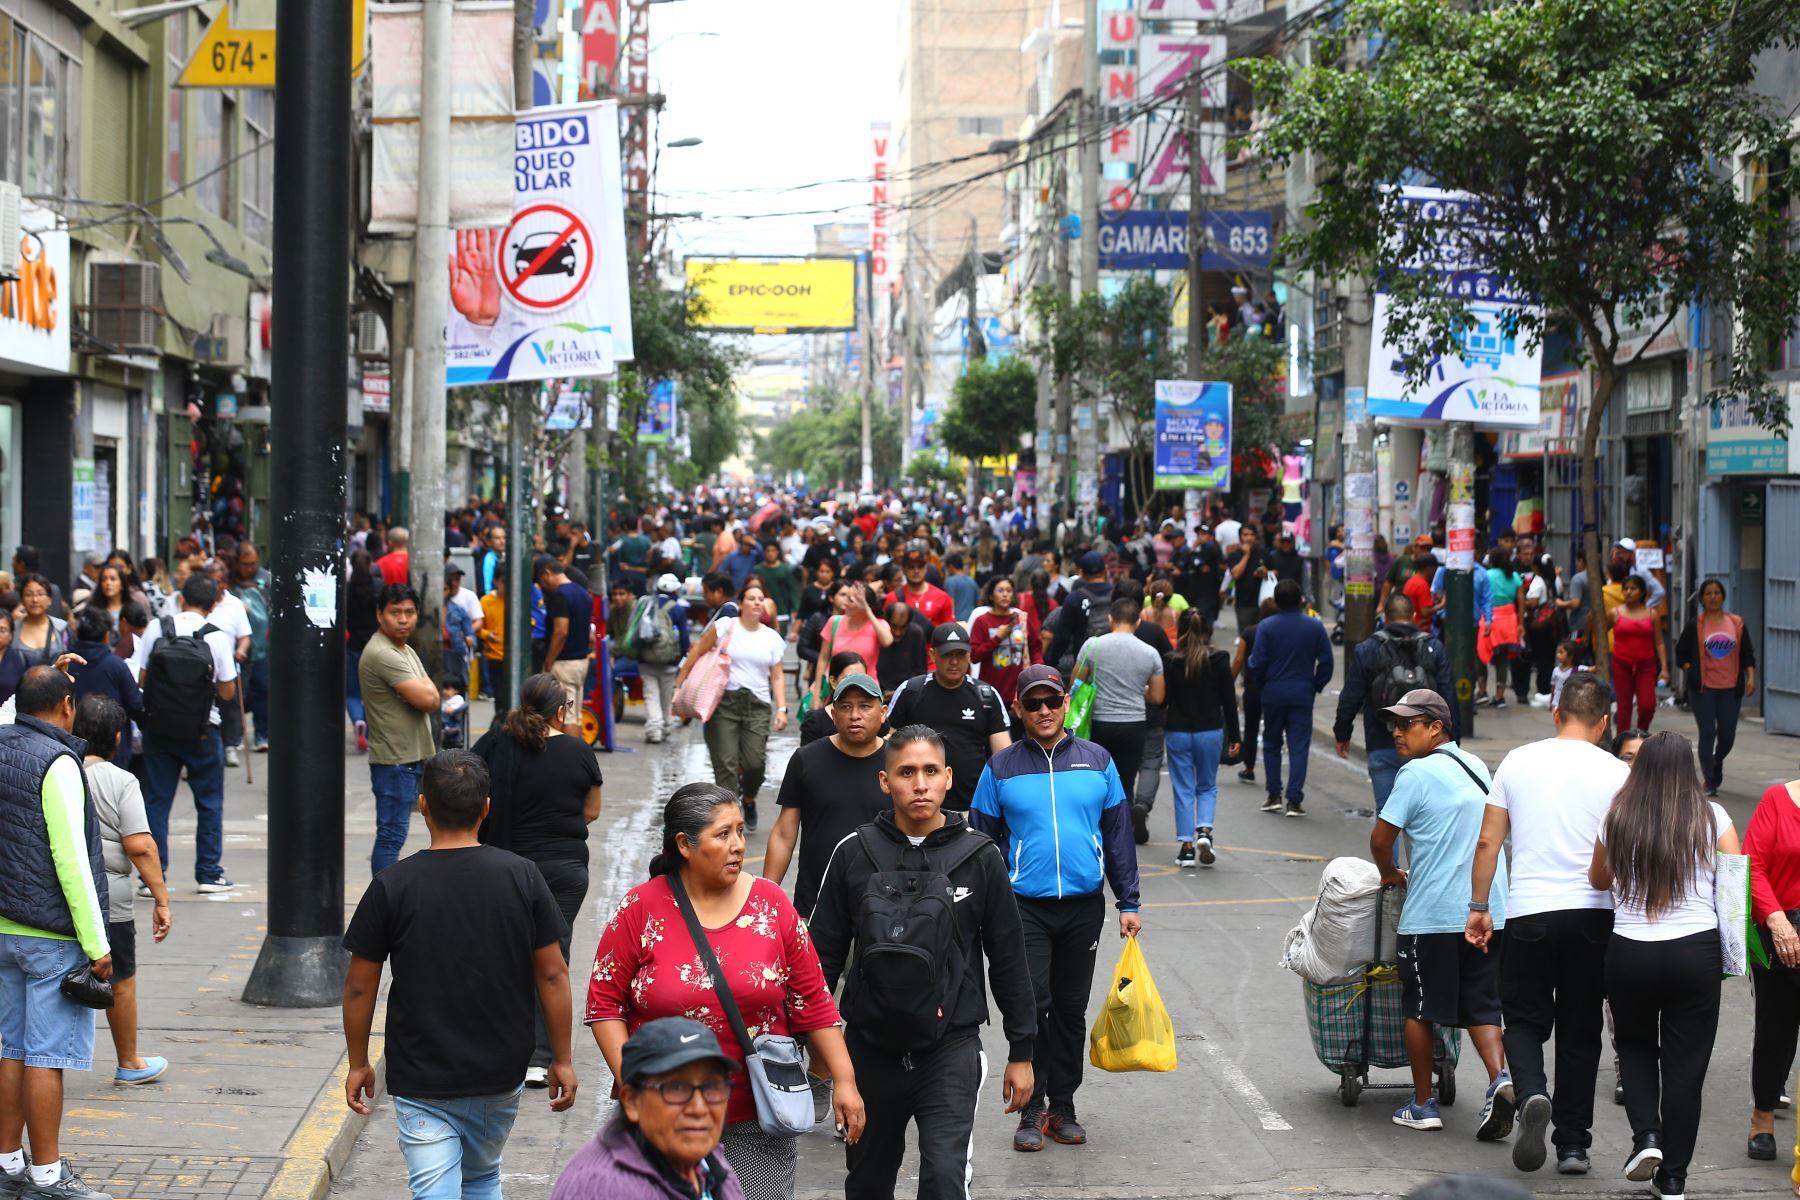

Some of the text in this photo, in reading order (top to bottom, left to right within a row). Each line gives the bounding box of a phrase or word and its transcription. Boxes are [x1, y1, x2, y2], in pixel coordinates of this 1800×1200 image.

[213, 41, 255, 74] 674
[516, 118, 586, 149] BIDO
[515, 151, 575, 175] QUEO
[515, 171, 571, 192] ULAR
[872, 137, 887, 276] VENERO
[1099, 225, 1268, 254] GAMARA 653
[562, 341, 579, 351] LA
[1493, 392, 1508, 401] LA
